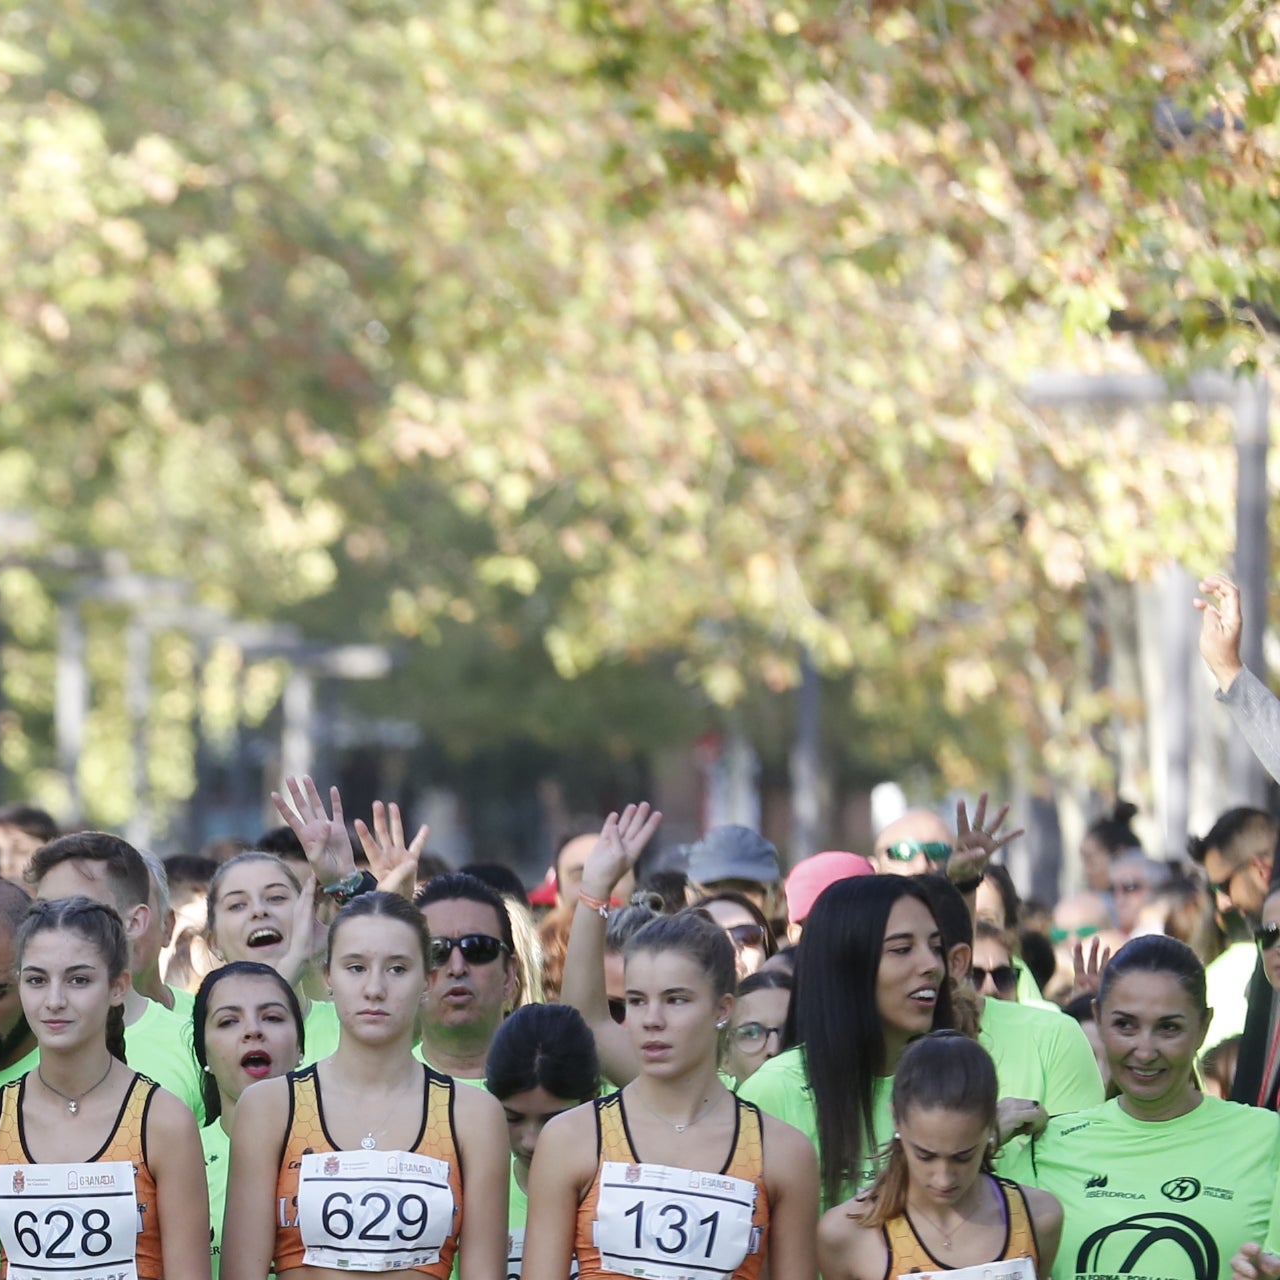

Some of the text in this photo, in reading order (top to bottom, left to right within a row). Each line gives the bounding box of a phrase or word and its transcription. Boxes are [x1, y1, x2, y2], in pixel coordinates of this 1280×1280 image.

[14, 1208, 113, 1258] 628
[322, 1192, 428, 1241] 629
[624, 1201, 720, 1258] 131
